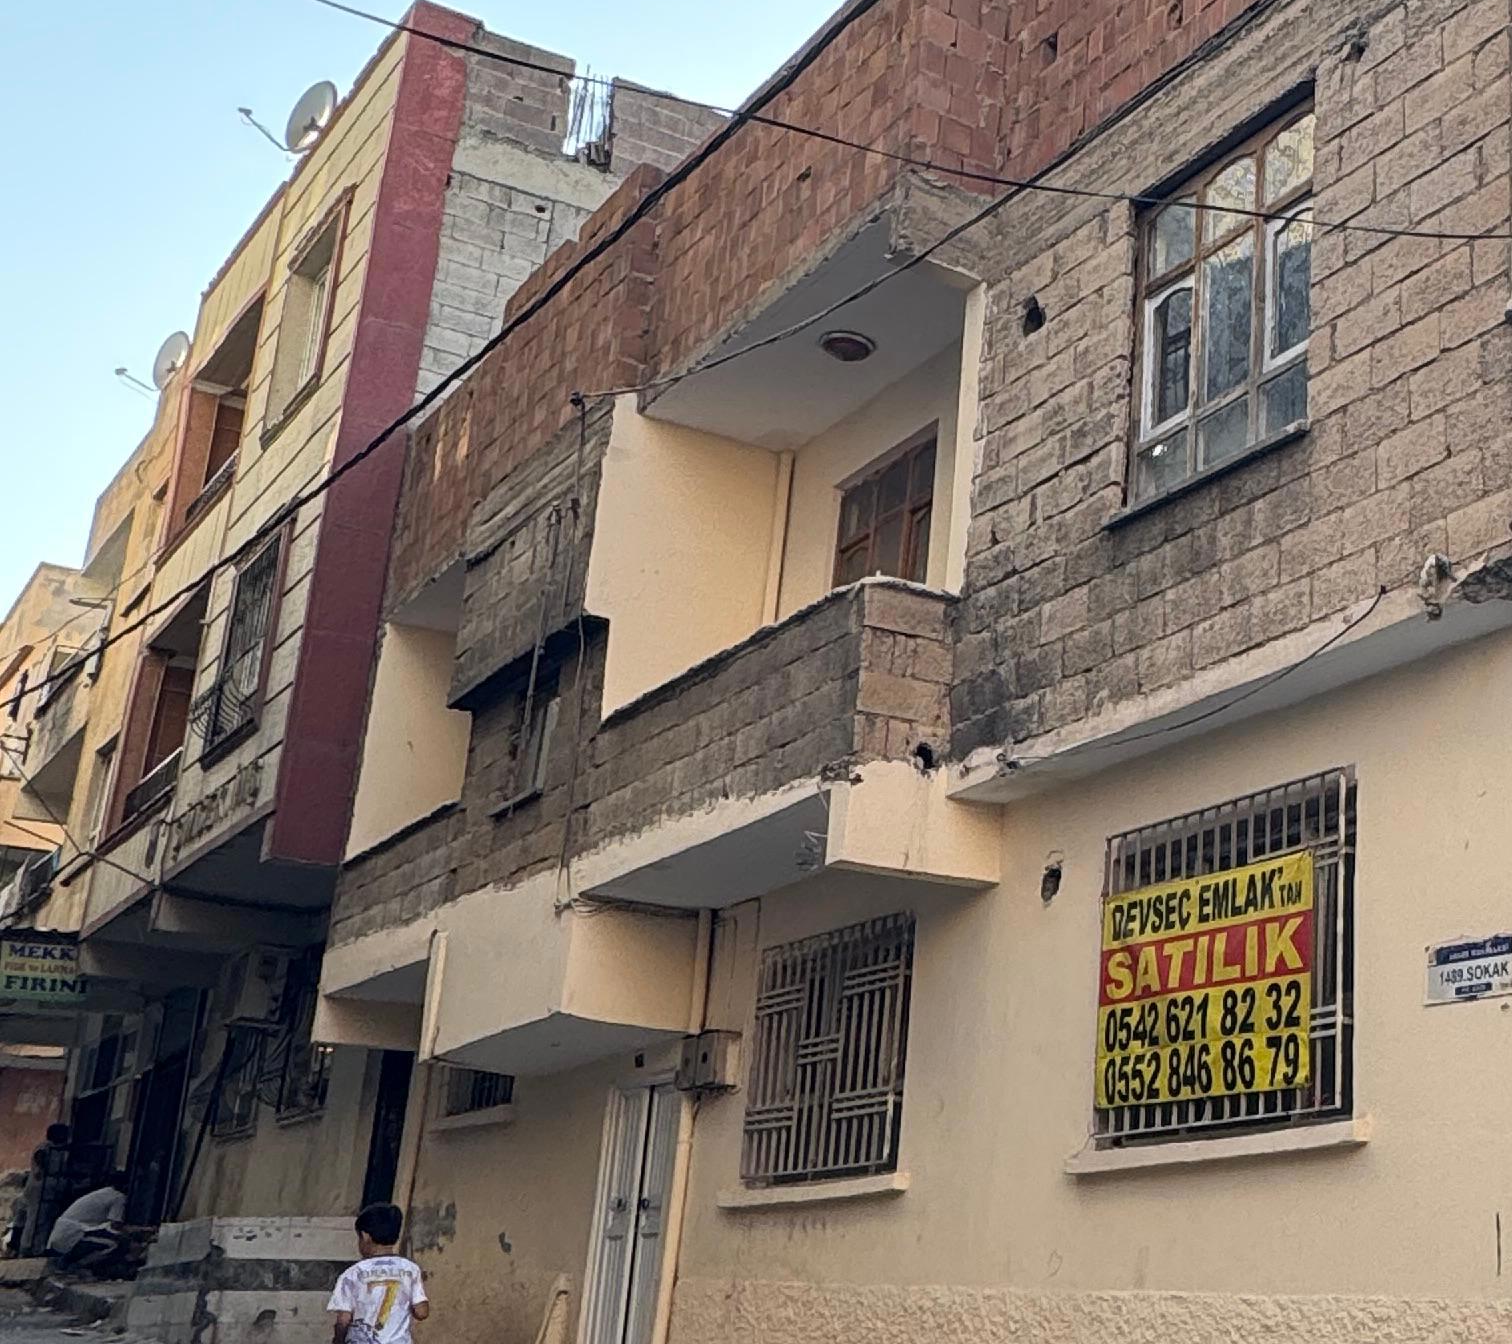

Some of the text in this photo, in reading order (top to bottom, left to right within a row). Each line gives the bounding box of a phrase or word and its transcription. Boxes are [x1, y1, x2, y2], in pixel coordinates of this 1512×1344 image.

[1106, 917, 1303, 999] SATILIK
[1105, 980, 1300, 1053] 0542 621 82 32
[1104, 1033, 1300, 1105] 0552 846 86 79
[367, 1279, 400, 1331] 7
